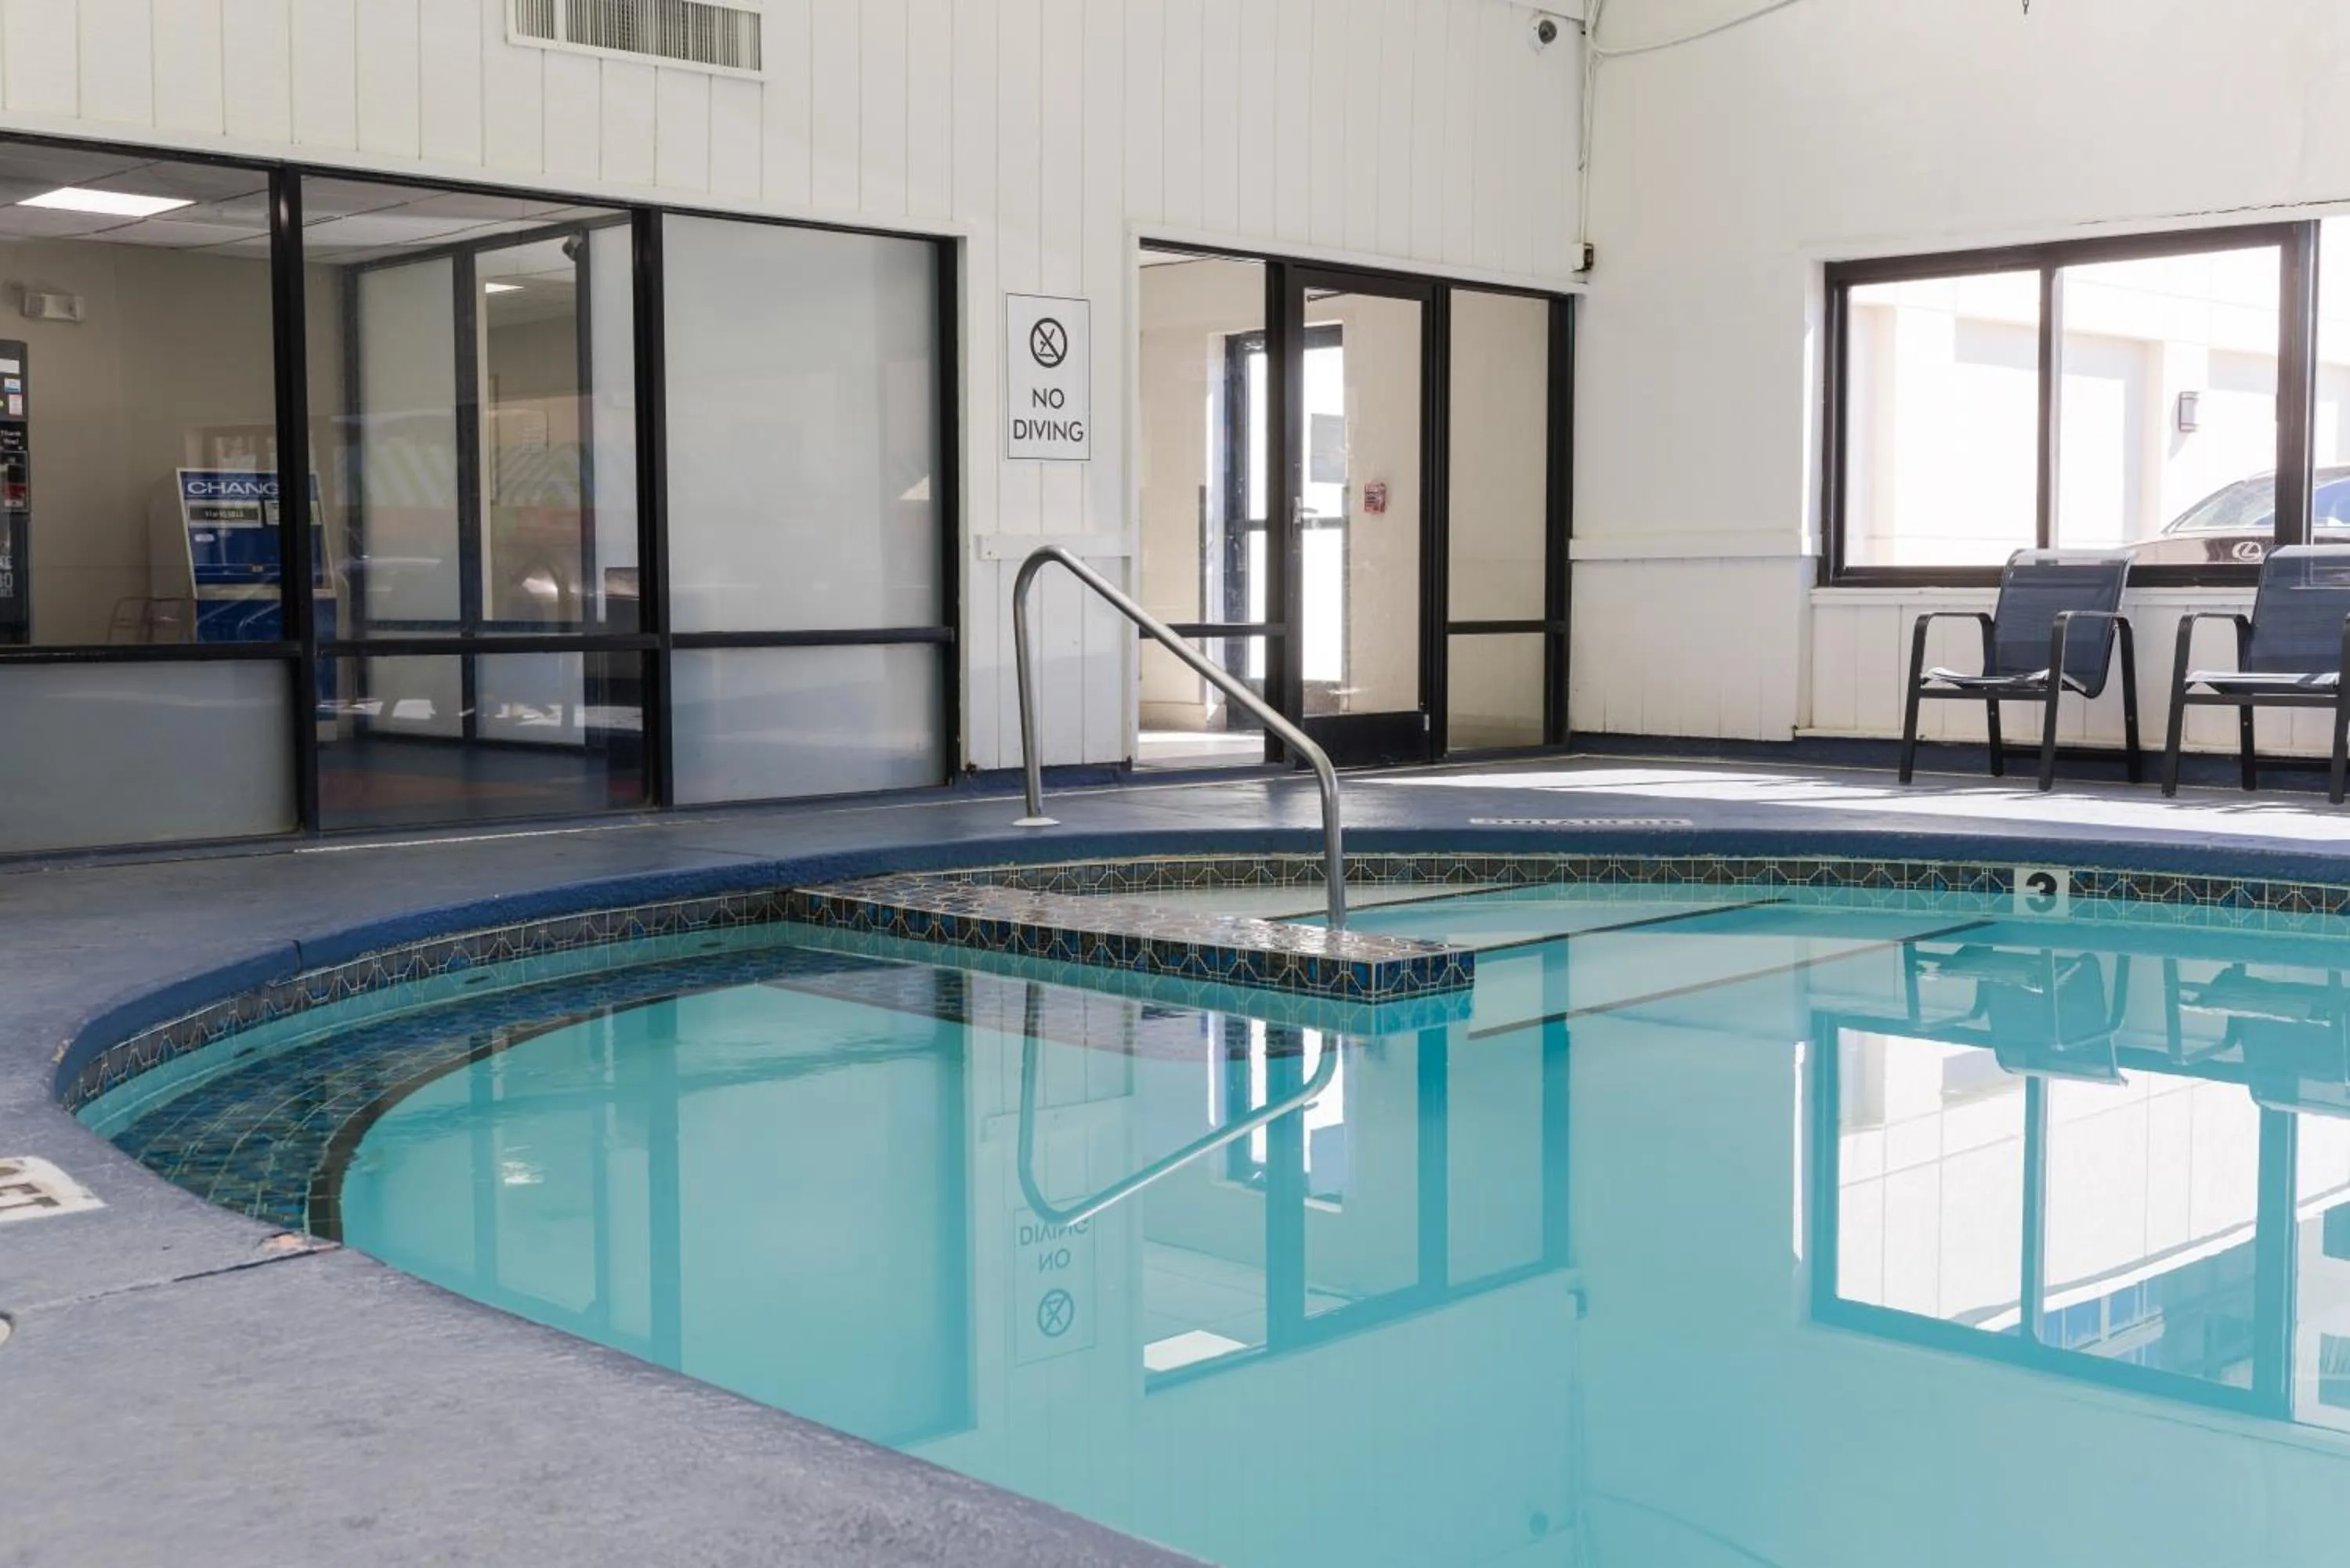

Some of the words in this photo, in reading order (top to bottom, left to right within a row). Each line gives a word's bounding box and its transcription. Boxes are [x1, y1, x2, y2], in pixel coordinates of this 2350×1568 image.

[1032, 388, 1065, 409] NO
[1013, 419, 1083, 442] DIVING
[188, 482, 279, 494] CHANG
